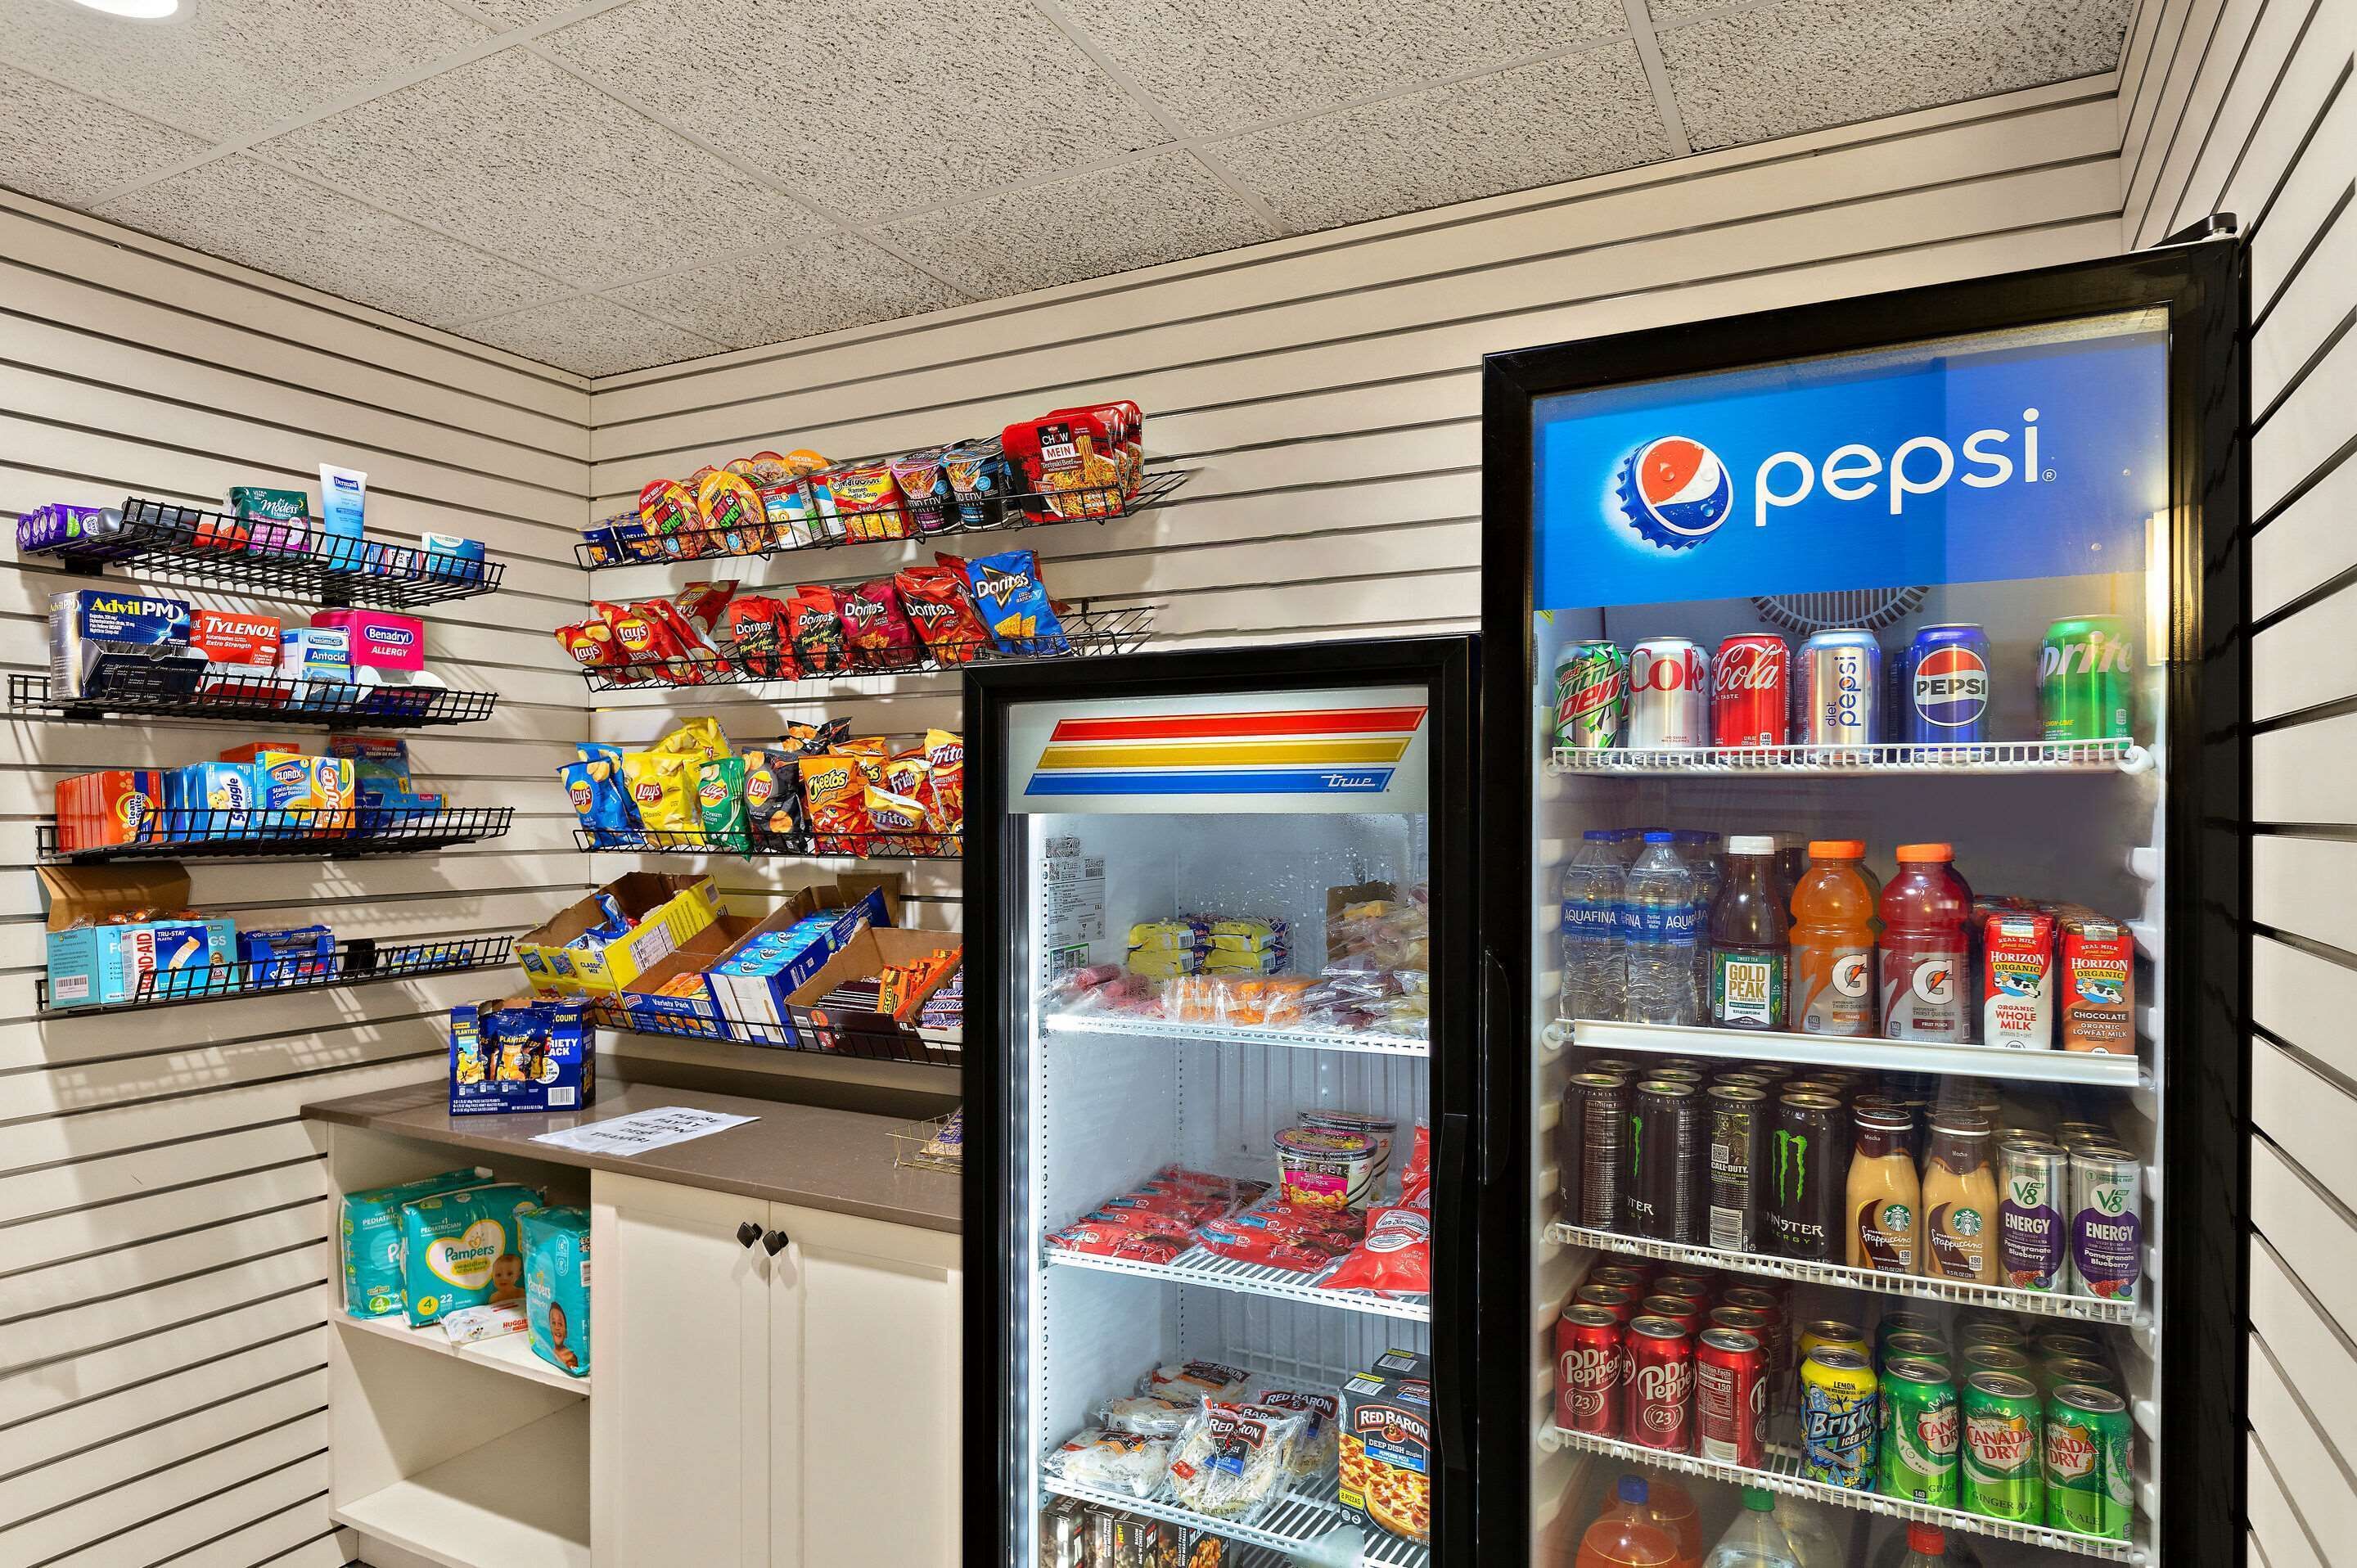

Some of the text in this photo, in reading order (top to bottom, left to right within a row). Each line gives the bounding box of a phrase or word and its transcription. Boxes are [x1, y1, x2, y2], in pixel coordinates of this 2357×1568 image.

[1043, 432, 1069, 445] CHOW
[1047, 447, 1071, 458] MEIN
[1755, 408, 2040, 527] pepsi
[261, 499, 299, 515] Modess
[719, 503, 741, 527] SPICY
[660, 511, 683, 534] SPICY
[976, 573, 1030, 597] Doritos
[90, 597, 173, 618] Advil PM
[845, 602, 885, 616] Doritos
[906, 602, 955, 616] Doritos
[205, 618, 277, 638] TYLENOL
[369, 629, 409, 643] Benadryl
[619, 625, 648, 642] Lay's
[736, 621, 771, 634] Doritos
[312, 651, 345, 662] Antacid
[372, 646, 407, 656] ALLERGY
[573, 643, 600, 661] Lay's
[2042, 631, 2133, 687] prite
[1561, 665, 1580, 682] diet
[1718, 643, 1782, 691] Cola
[1834, 656, 1861, 727] pepsi
[1917, 678, 1985, 696] PEPSI
[1825, 701, 1836, 727] diet
[275, 769, 301, 781] CLOROX
[891, 771, 915, 794] Fritos
[1321, 773, 1377, 788] true
[637, 783, 662, 799] Lay's
[700, 783, 728, 799] Lay's
[748, 778, 772, 799] Lay's
[808, 770, 848, 800] Cheetos
[227, 777, 245, 827] Snuggle
[572, 786, 592, 805] Lay's
[876, 811, 913, 827] Fritos
[1565, 909, 1616, 924] AQUAFINA
[136, 933, 154, 992] BAND-AID
[1990, 951, 2044, 965] HORIZON
[2071, 957, 2128, 971] HORIZON
[1729, 964, 1765, 982] GOLD
[1832, 954, 1868, 998] G
[1995, 964, 2039, 972] ORGANIC
[2077, 971, 2124, 979] ORGANIC
[1728, 981, 1766, 998] PEAK
[1912, 959, 1954, 1005] G
[652, 999, 689, 1009] Variety Pack
[556, 1014, 577, 1022] COUNT
[1995, 1011, 2036, 1021] WHOLE
[2074, 1011, 2126, 1021] CHOCOLATE
[899, 1022, 908, 1030] 48
[2000, 1021, 2031, 1030] MILK
[2073, 1029, 2106, 1037] LOWFAT
[499, 1035, 530, 1043] PLANTERS
[1952, 1150, 1968, 1158] Mocha
[1710, 1162, 1726, 1170] CALL
[2012, 1182, 2038, 1205] V8
[2097, 1189, 2123, 1213] V8
[421, 1223, 462, 1233] PEDIATRICIAN
[2005, 1212, 2051, 1235] ENERGY
[2086, 1221, 2134, 1241] ENERGY
[1862, 1226, 1912, 1247] frappuccino
[1931, 1228, 1982, 1251] frappuccino
[444, 1245, 494, 1263] Pampers
[2005, 1239, 2051, 1254] Pomegranate
[2009, 1248, 2044, 1261] Blueberry
[2084, 1250, 2134, 1261] Pomegranate
[2091, 1259, 2129, 1269] Blueberry
[527, 1274, 552, 1300] Pampers
[423, 1299, 432, 1309] 4
[439, 1294, 453, 1304] 22
[1583, 1349, 1608, 1368] Dr
[1561, 1349, 1620, 1388] Pepper
[1665, 1362, 1688, 1383] Dr
[1833, 1381, 1855, 1390] LEMON
[1267, 1394, 1332, 1413] RED BARON
[1575, 1395, 1590, 1409] 23
[1211, 1419, 1233, 1432] RED
[1360, 1411, 1428, 1440] RED BARON
[1656, 1411, 1671, 1425] 23
[1841, 1427, 1872, 1447] ICED TEA
[1918, 1417, 1957, 1441] CANA
[1967, 1426, 2034, 1447] CANADA
[1369, 1439, 1404, 1453] DEEP DISH
[1983, 1445, 2021, 1459] DRY
[2048, 1435, 2098, 1454] NADA
[2049, 1450, 2082, 1468] DRY
[1341, 1489, 1362, 1506] 2 PIZZAS
[1972, 1490, 2014, 1510] GINGER
[2075, 1512, 2100, 1525] ALE
